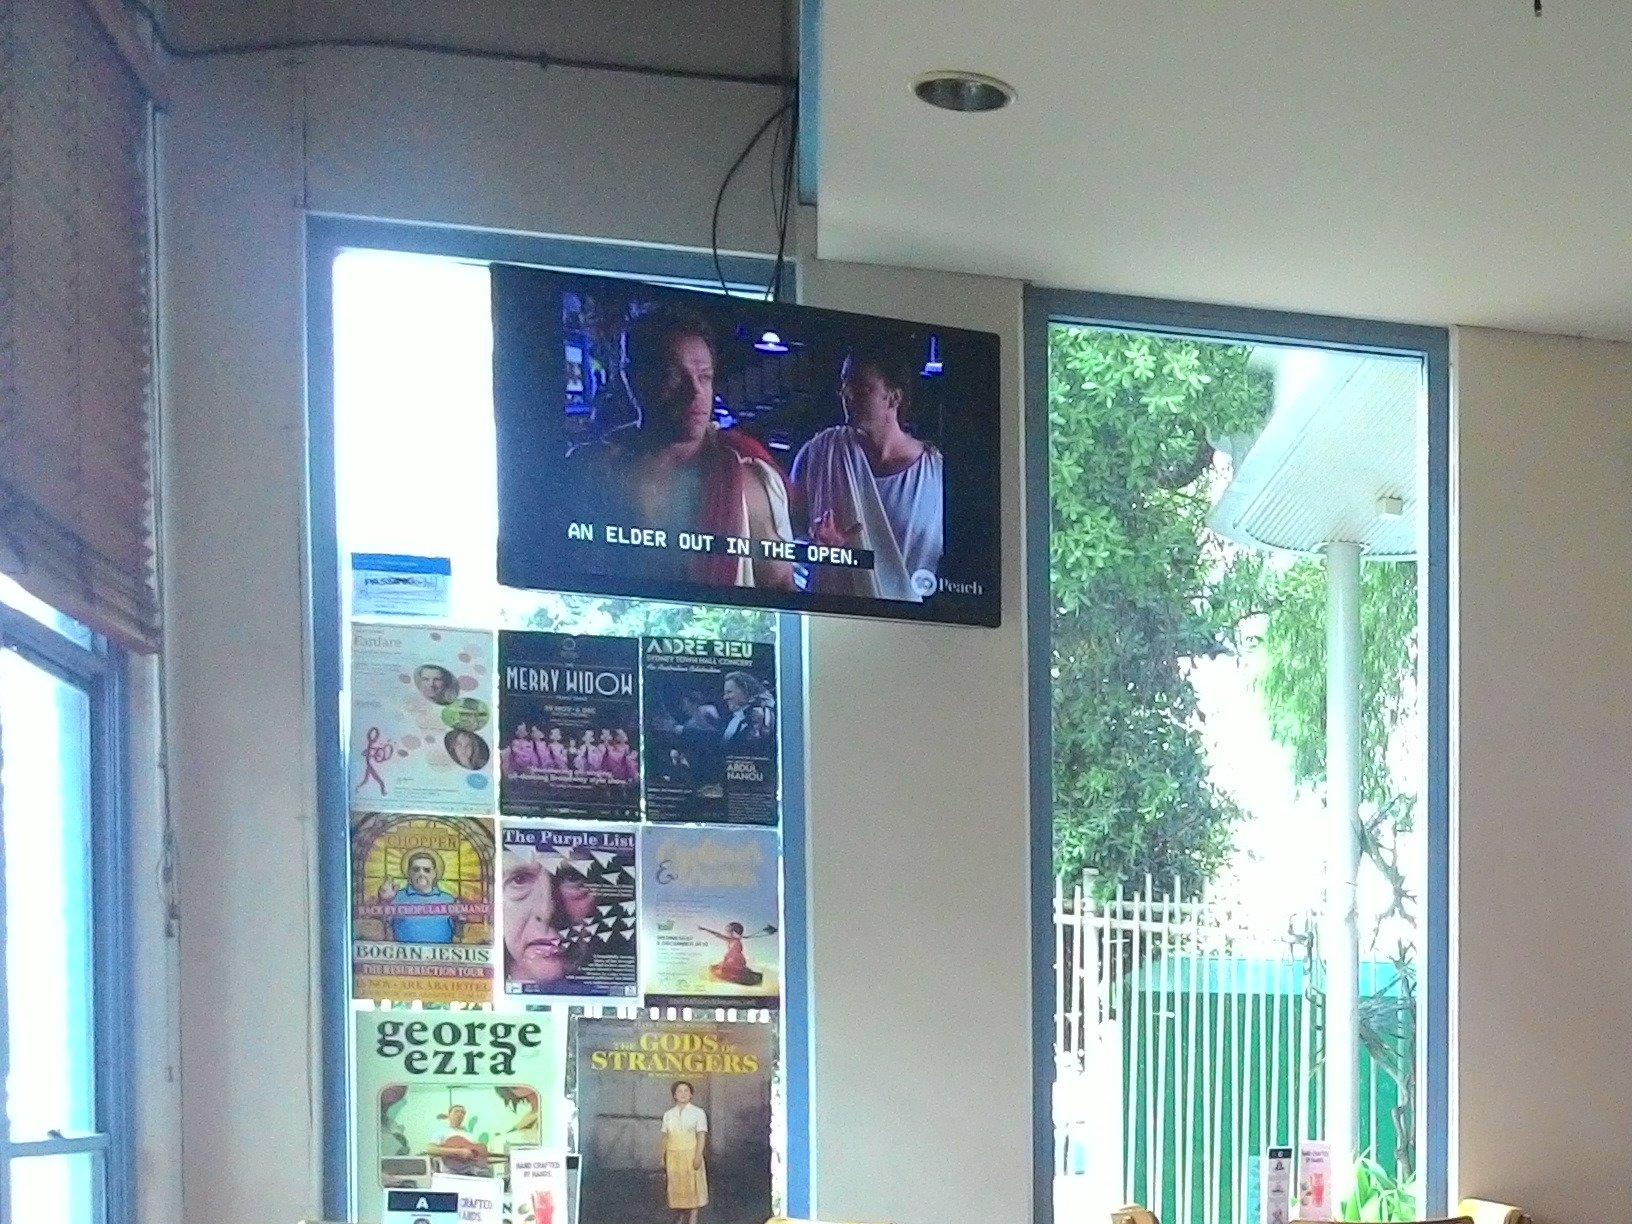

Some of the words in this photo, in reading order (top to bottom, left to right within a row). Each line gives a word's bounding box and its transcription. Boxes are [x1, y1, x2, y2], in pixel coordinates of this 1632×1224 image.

[568, 521, 594, 541] AN
[607, 525, 667, 548] ELDER
[679, 532, 713, 552] OUT
[727, 535, 750, 556] IN
[760, 540, 796, 560] THE
[807, 545, 859, 566] OPEN.
[937, 576, 984, 596] Peach
[713, 641, 754, 658] RIEU
[506, 665, 560, 693] MERRY
[565, 669, 633, 696] WIDOW
[387, 834, 458, 850] CHOPPER
[505, 829, 536, 844] The
[541, 831, 599, 848] Purple
[602, 834, 635, 848] List
[357, 945, 423, 960] BOGAN
[426, 947, 490, 962] JESUS
[376, 1020, 542, 1058] george
[639, 1033, 720, 1051] GODS
[404, 1049, 517, 1076] ezra
[591, 1051, 760, 1074] STRANGERS
